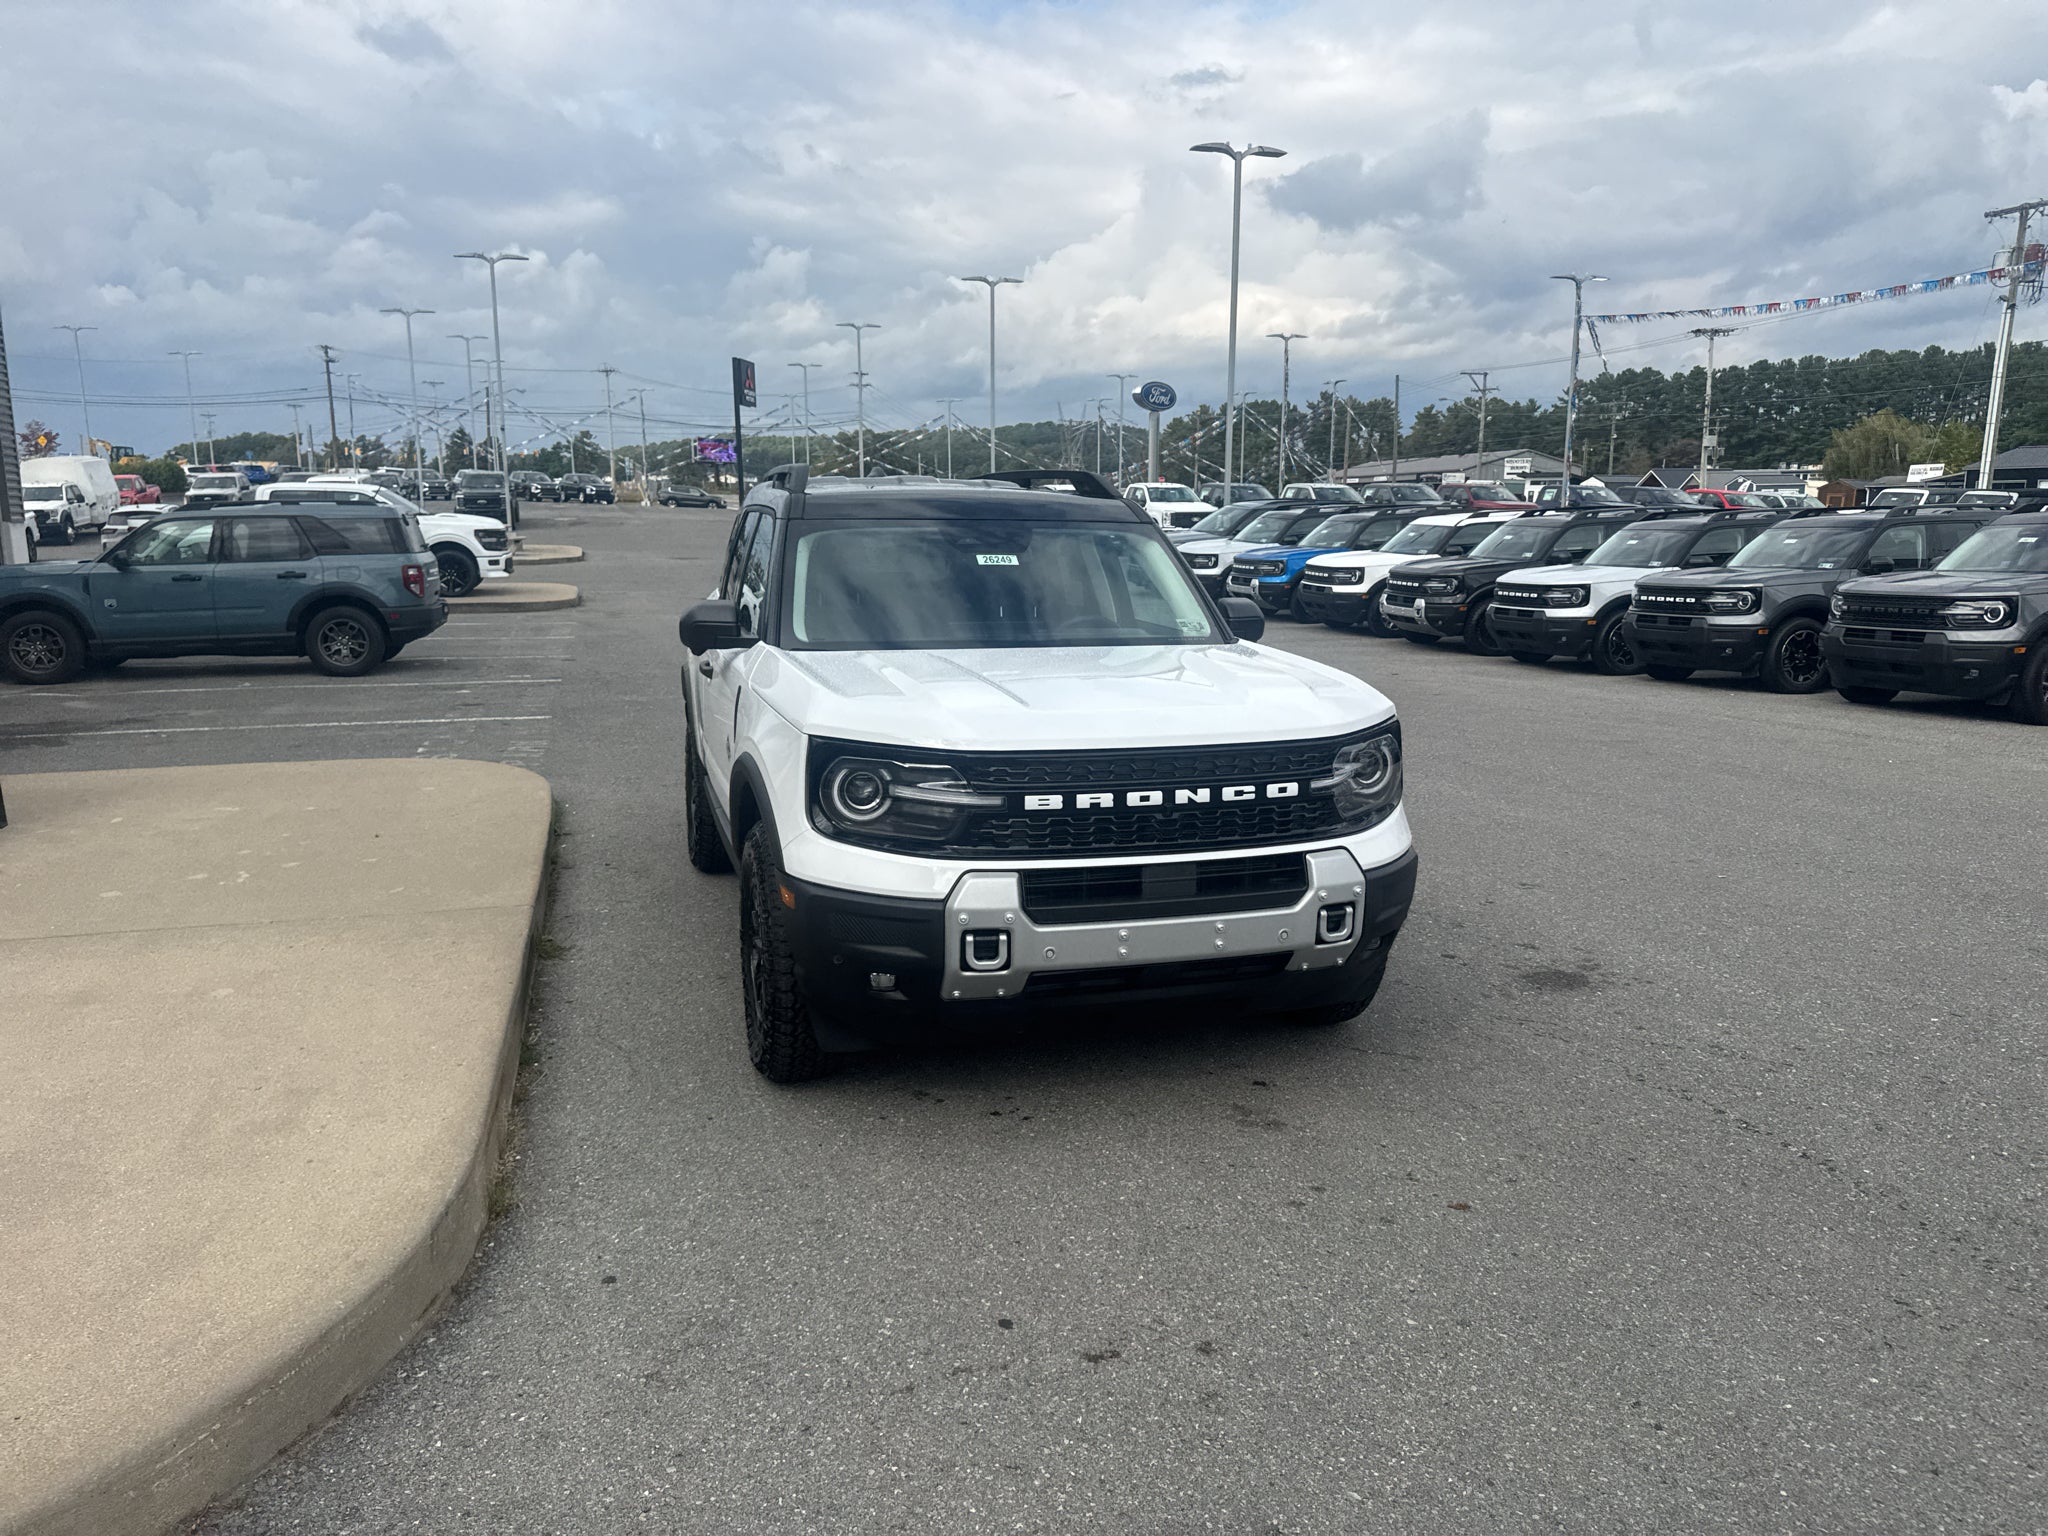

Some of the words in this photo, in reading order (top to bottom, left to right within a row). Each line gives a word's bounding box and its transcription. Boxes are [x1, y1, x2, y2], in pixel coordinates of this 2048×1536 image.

[1149, 386, 1171, 405] Ford
[982, 555, 1013, 564] 26249
[1640, 595, 1696, 603] BRONCO
[1024, 782, 1299, 811] BRONCO
